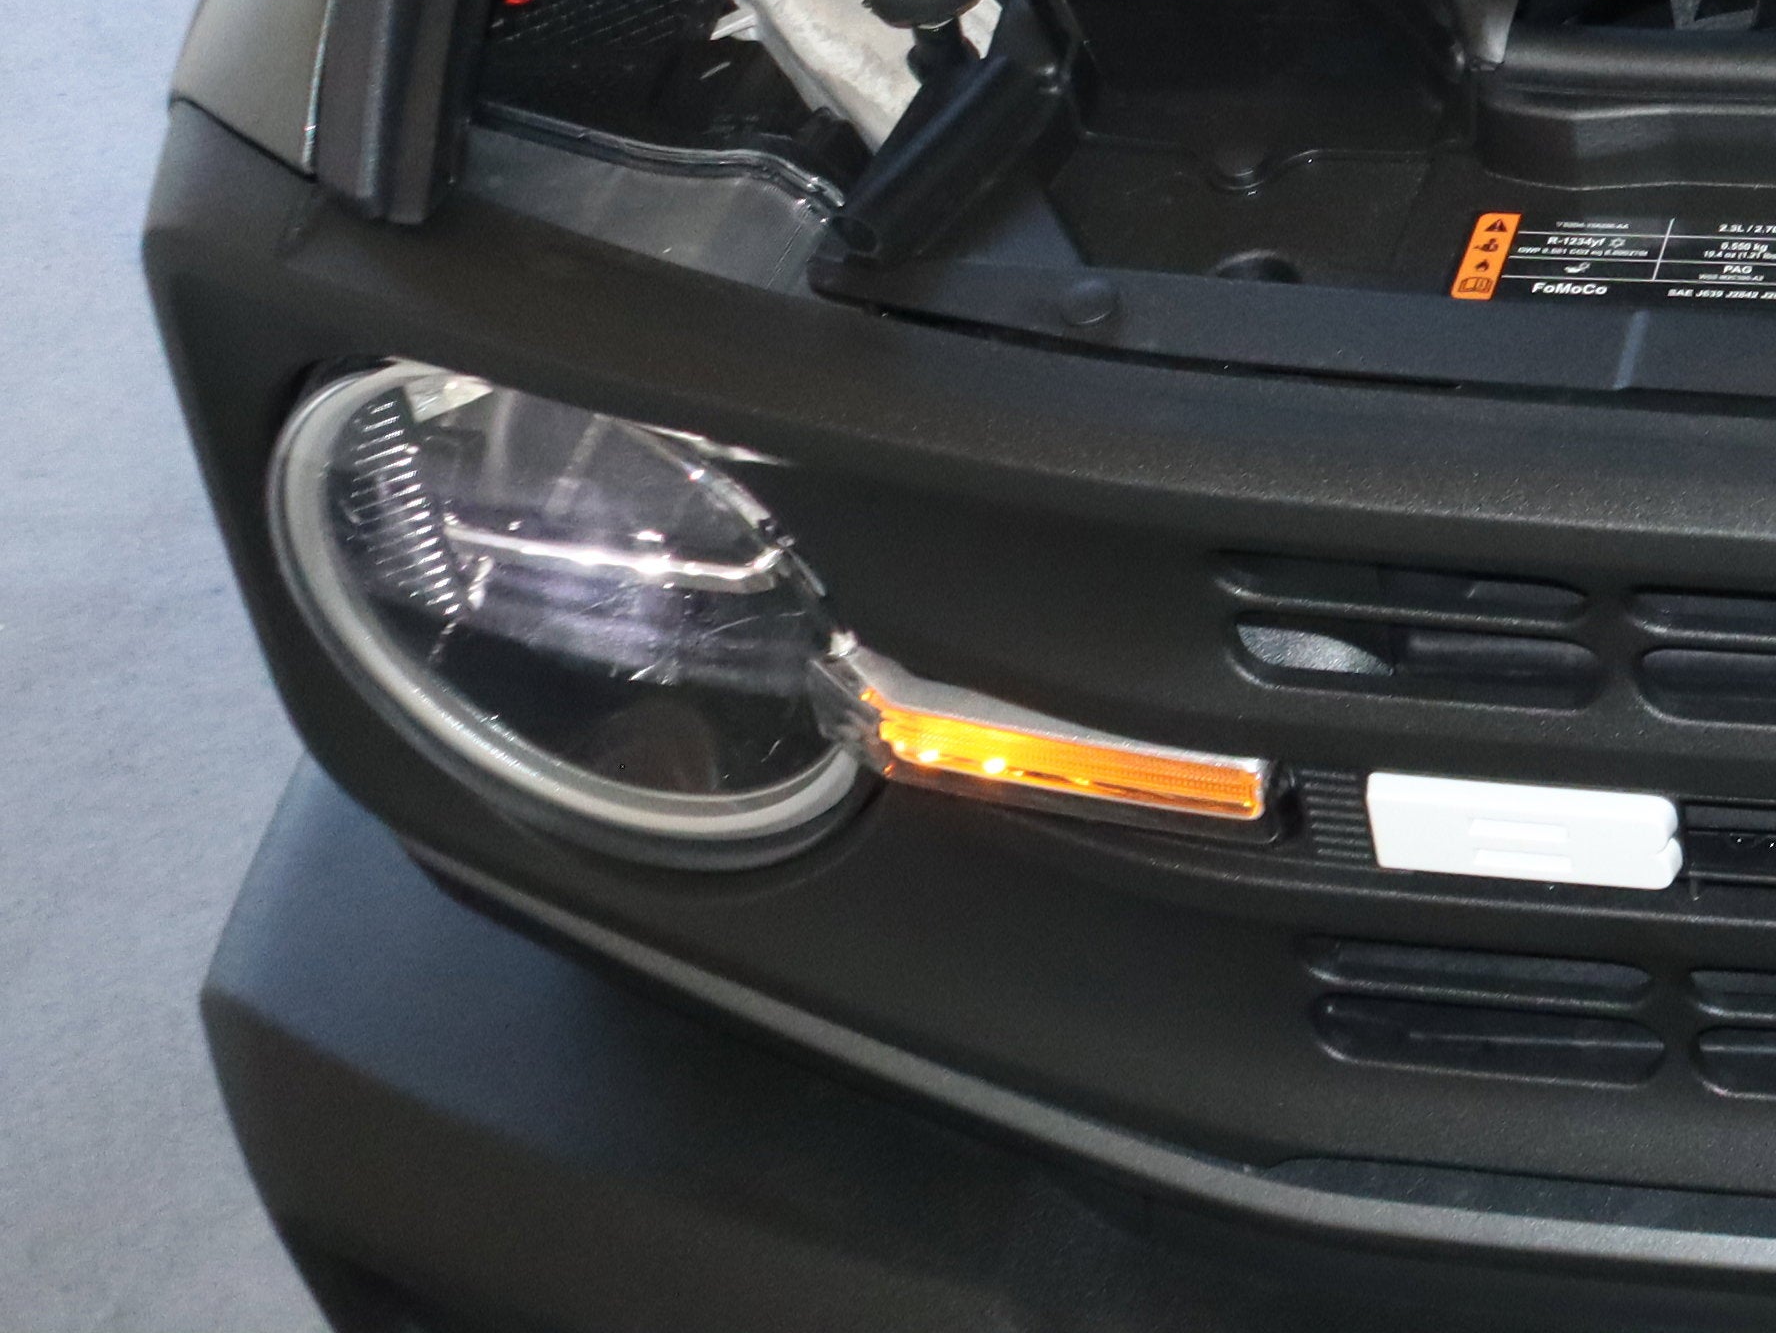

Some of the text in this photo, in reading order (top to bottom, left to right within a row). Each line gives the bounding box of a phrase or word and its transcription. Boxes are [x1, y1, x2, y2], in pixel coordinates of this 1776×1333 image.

[1547, 237, 1606, 248] R-1234yf
[1753, 243, 1769, 253] kg
[1723, 265, 1752, 274] PAG
[1531, 282, 1608, 295] FoMoCo
